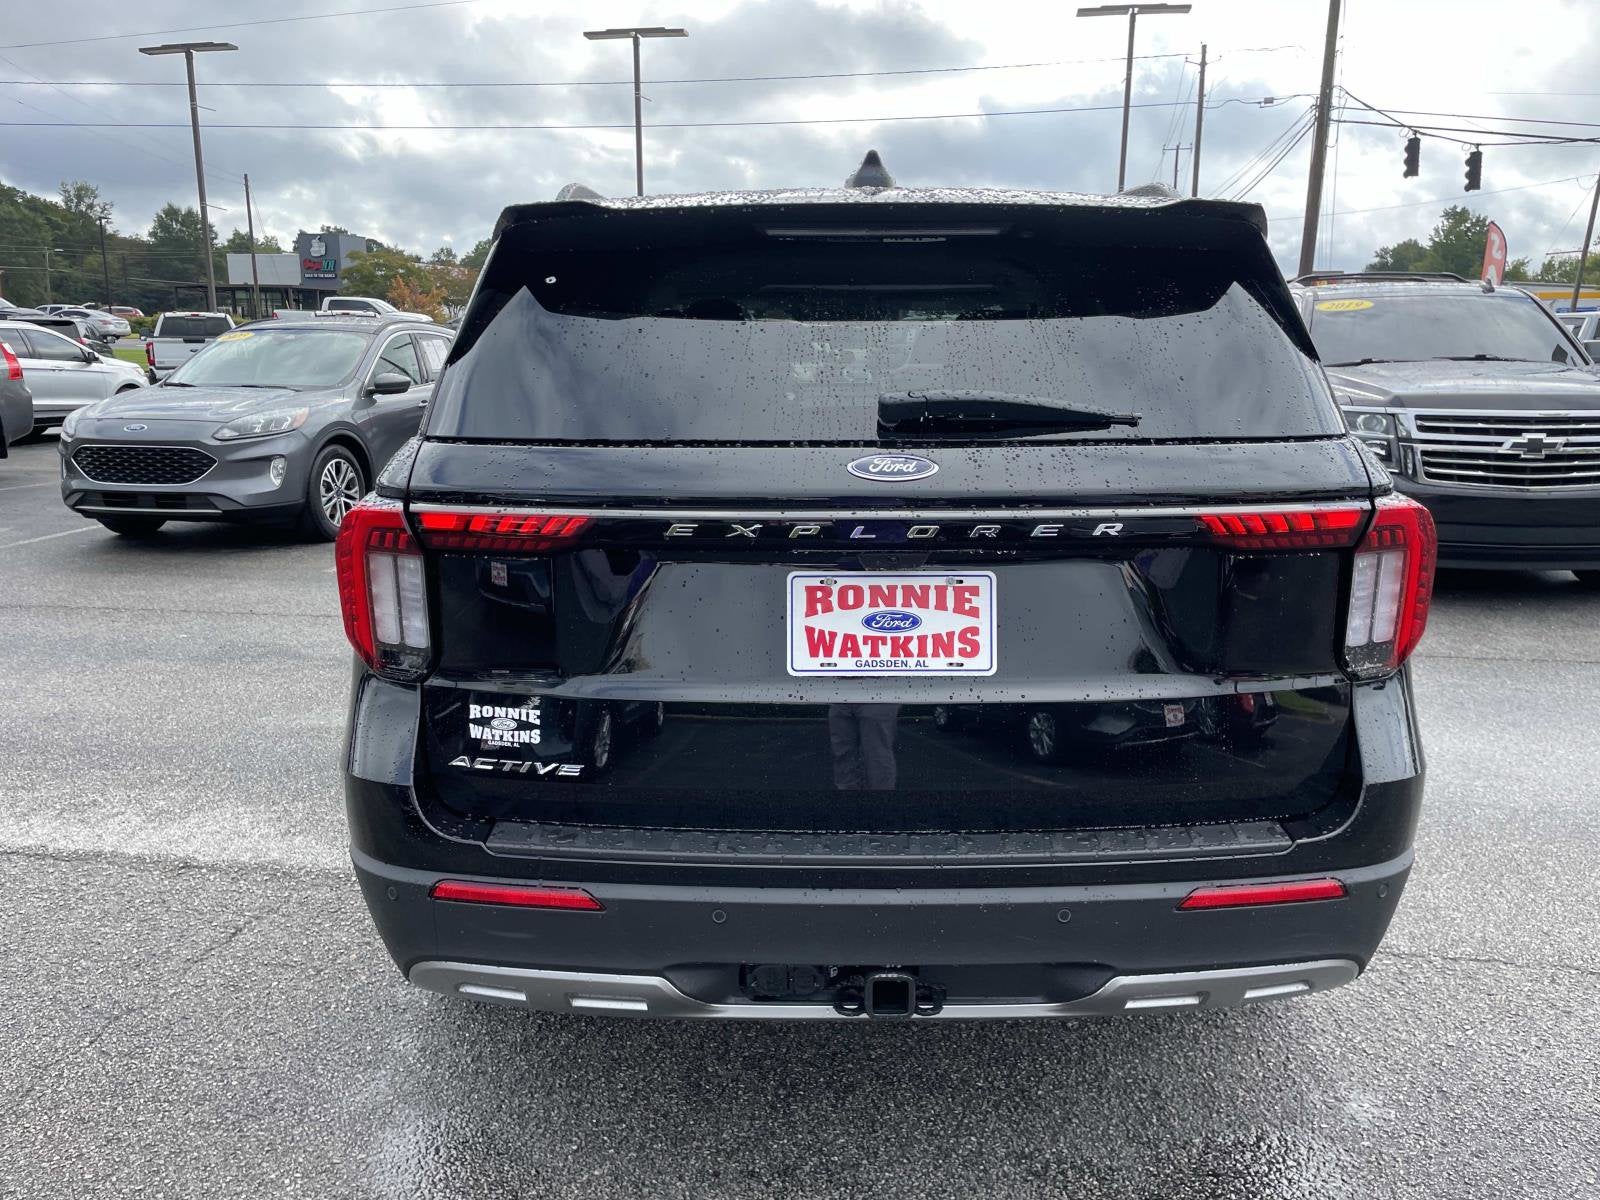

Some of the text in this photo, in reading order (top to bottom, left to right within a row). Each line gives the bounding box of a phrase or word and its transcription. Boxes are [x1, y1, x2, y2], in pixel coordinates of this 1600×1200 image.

[868, 458, 917, 473] Ford
[664, 522, 1124, 539] EXPLORER
[804, 584, 980, 619] RONNIE
[871, 612, 913, 629] Ford
[804, 625, 981, 659] WATKINS
[855, 659, 929, 669] GADSDEN, AL
[469, 704, 541, 725] RONNIE
[469, 723, 541, 744] WATKINS
[448, 756, 585, 776] ACTIVE
